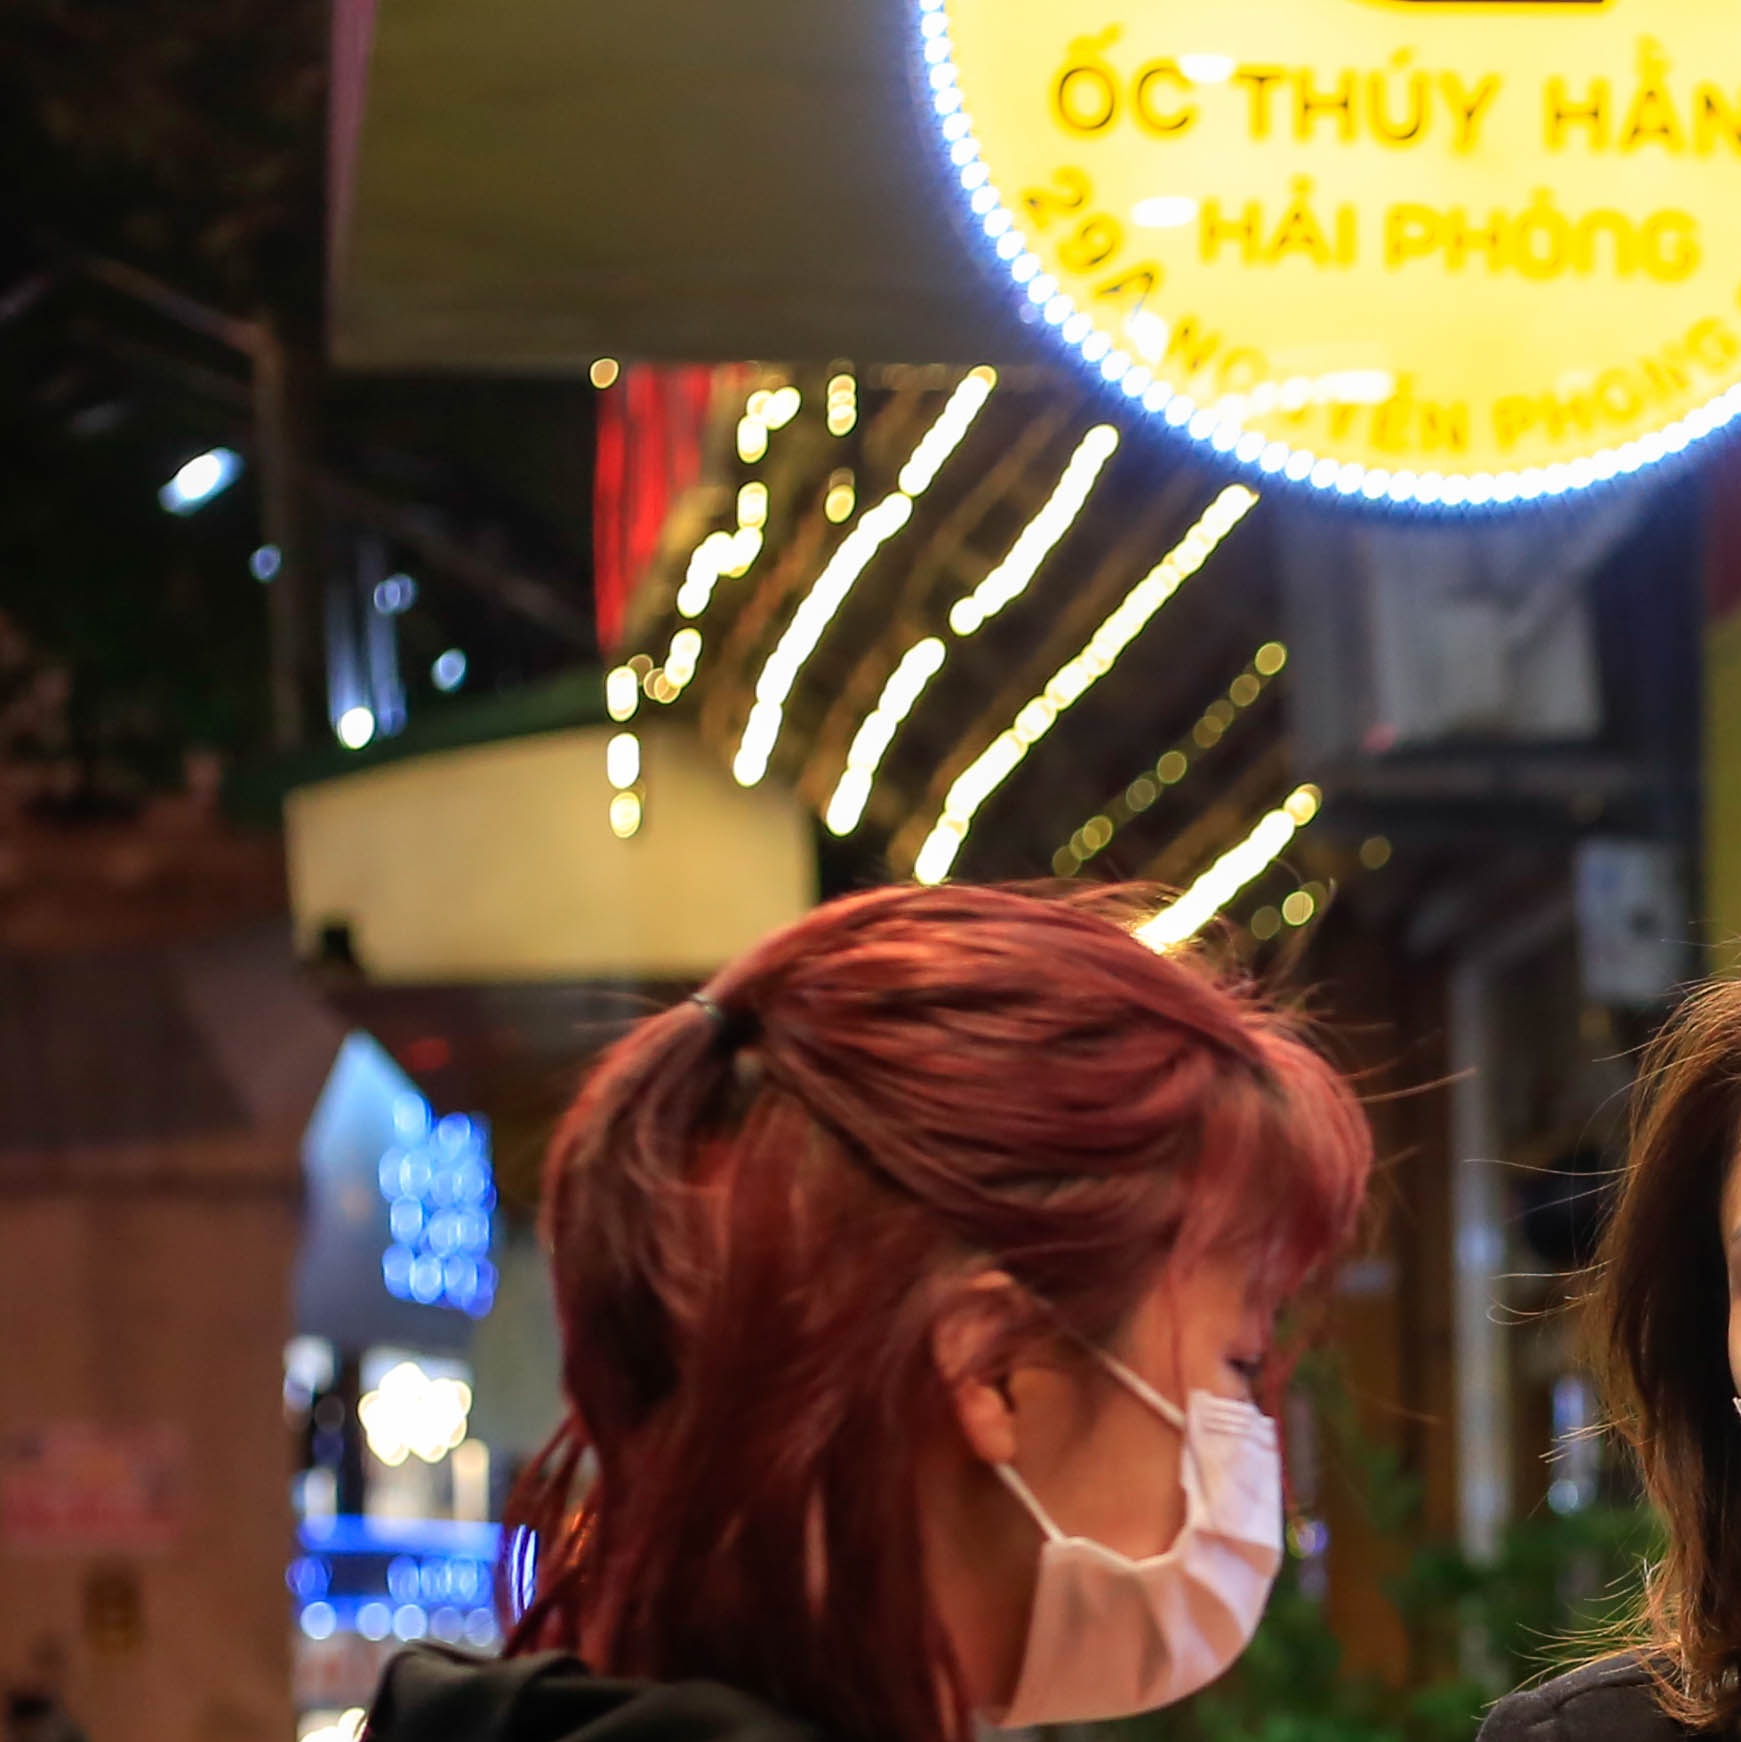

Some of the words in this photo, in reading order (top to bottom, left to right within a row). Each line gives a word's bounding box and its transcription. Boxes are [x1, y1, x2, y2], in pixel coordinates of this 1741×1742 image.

[1050, 24, 1199, 140] ỐC
[1229, 46, 1502, 156] THÚY
[1199, 172, 1357, 270] HẢI
